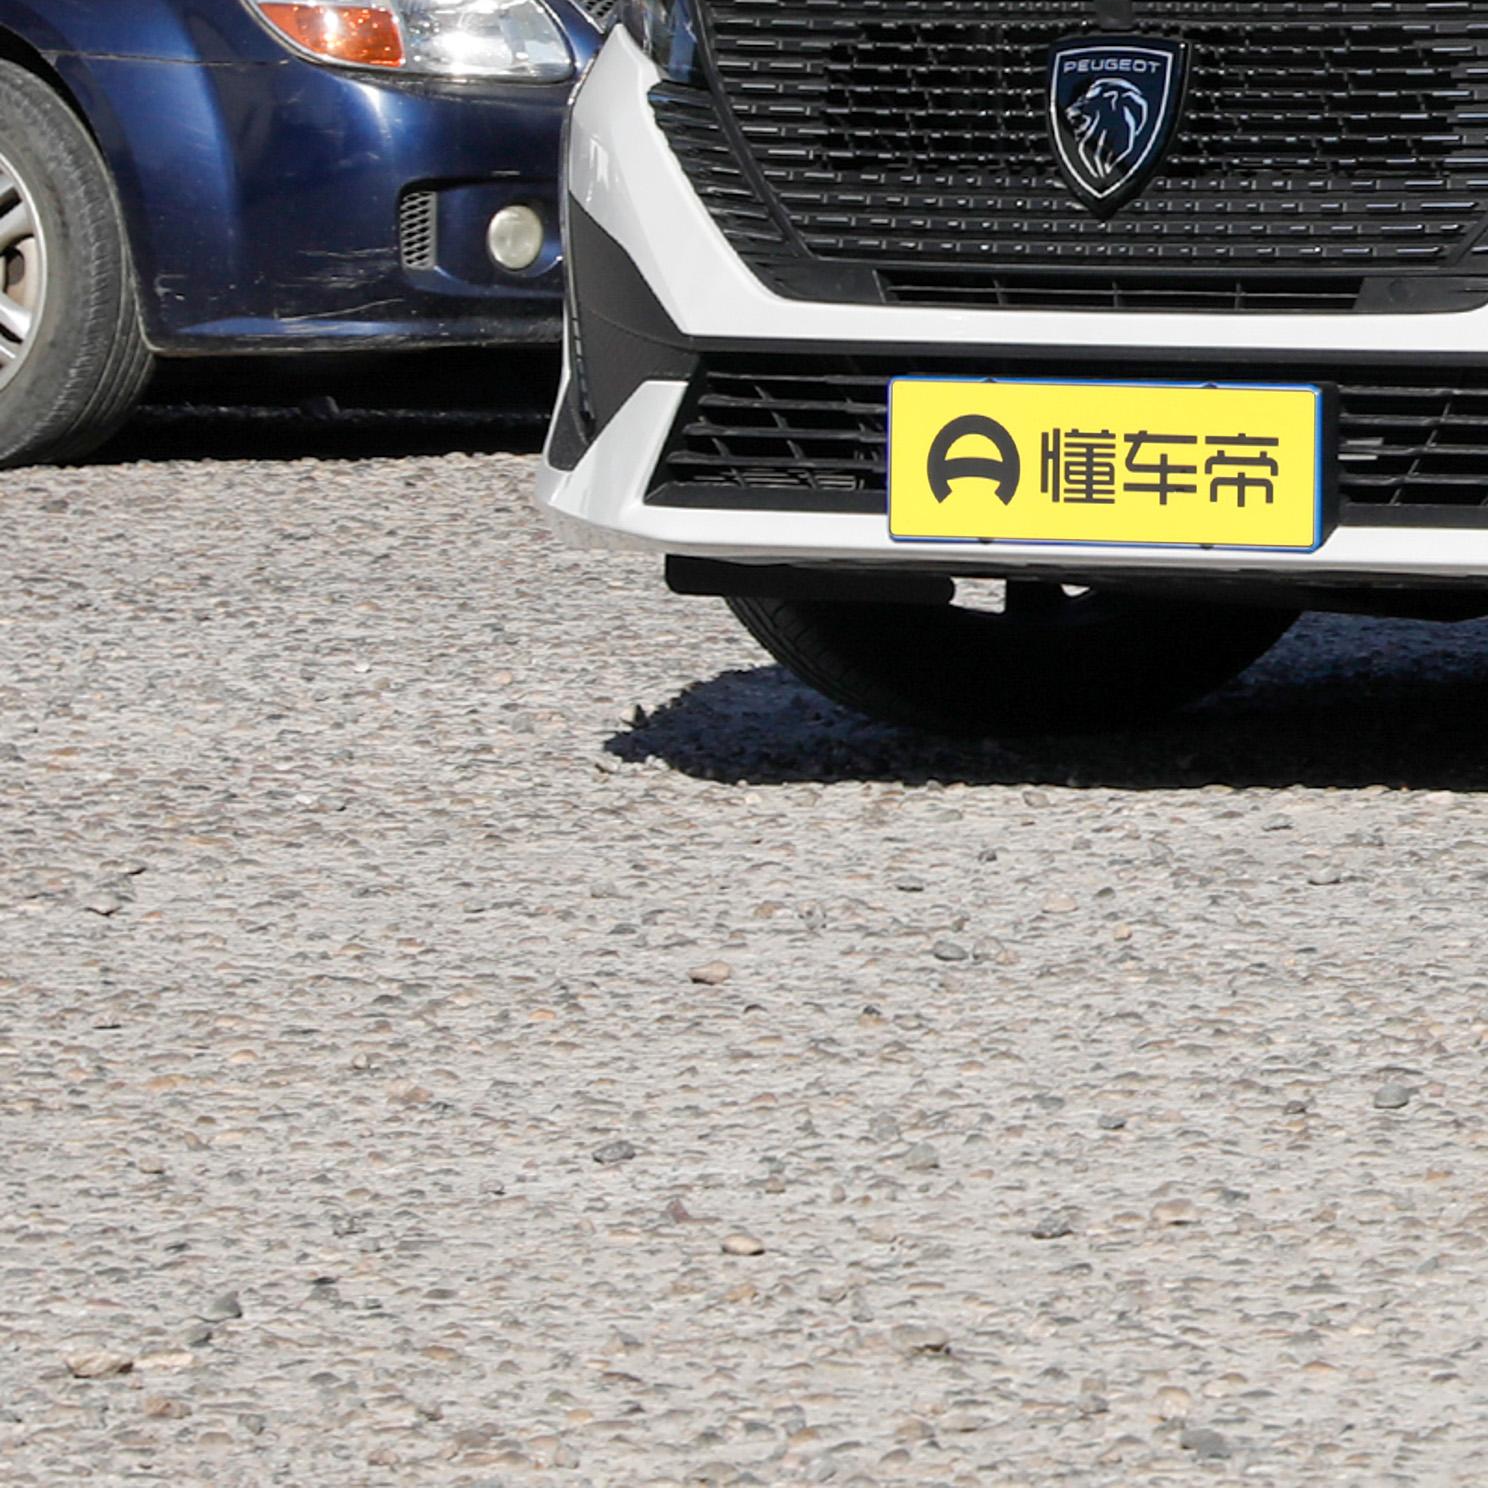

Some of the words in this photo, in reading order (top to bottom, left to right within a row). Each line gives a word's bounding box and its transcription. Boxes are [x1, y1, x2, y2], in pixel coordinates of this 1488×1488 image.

[1063, 58, 1161, 74] PEUGEOT
[1041, 427, 1280, 509] 懂车帝
